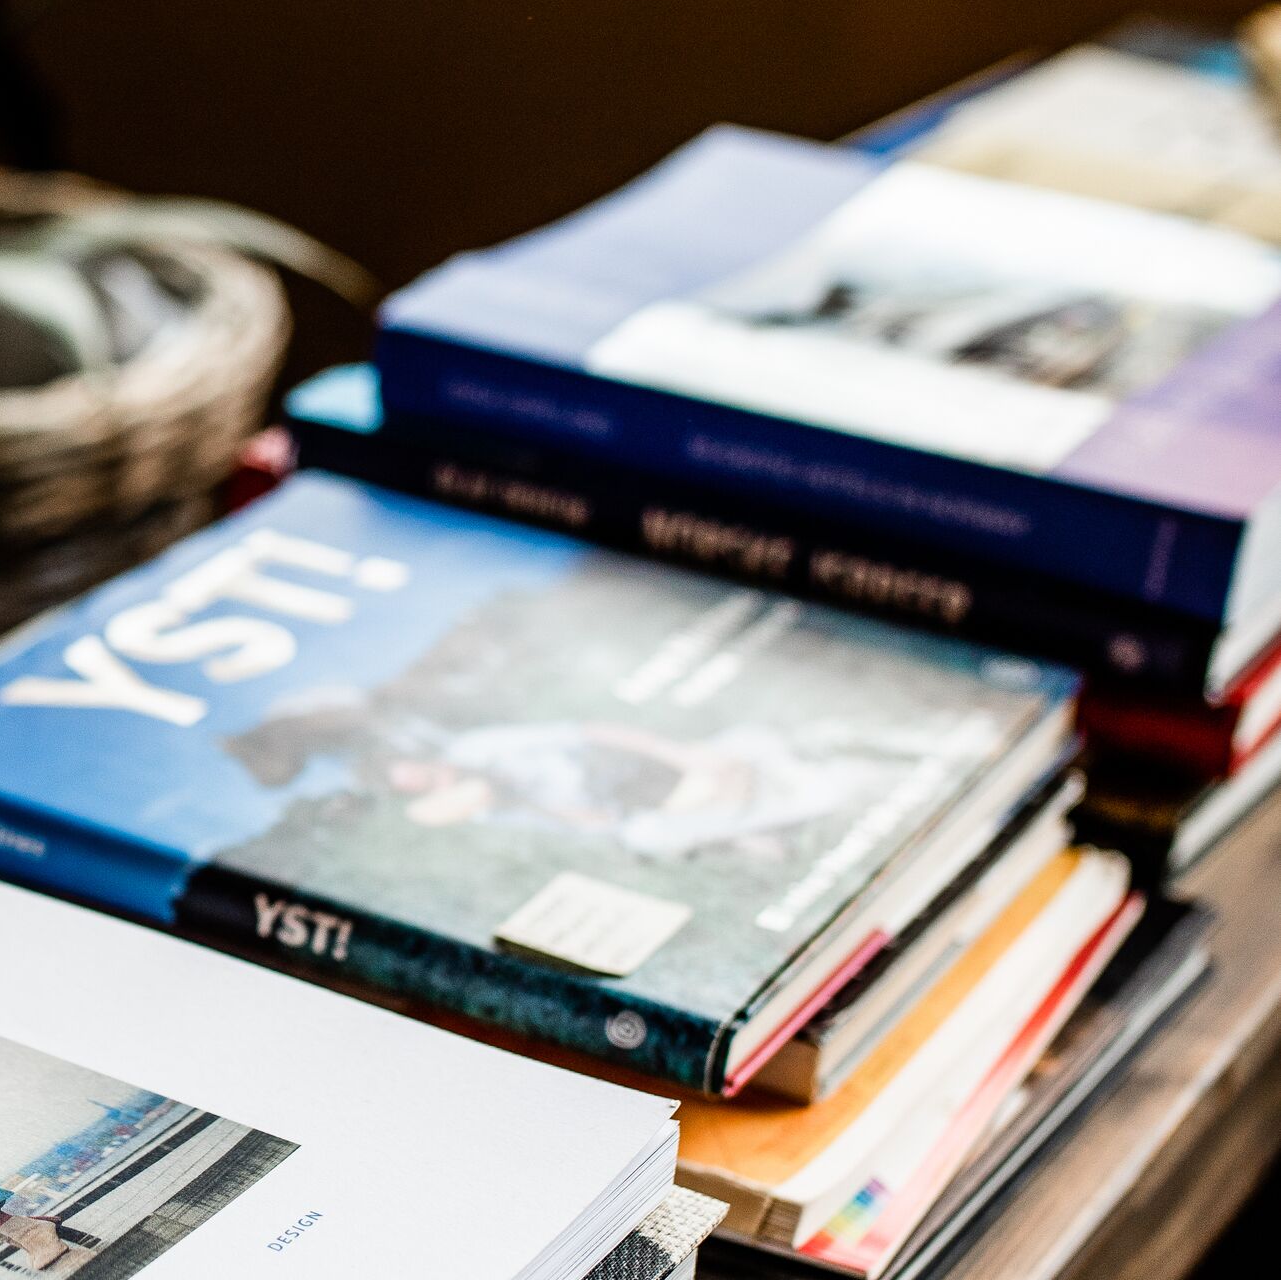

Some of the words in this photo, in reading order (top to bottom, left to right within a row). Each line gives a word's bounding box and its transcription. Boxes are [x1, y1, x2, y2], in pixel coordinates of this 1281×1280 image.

[0, 528, 411, 728] YST!
[254, 893, 354, 961] YST!
[266, 1210, 324, 1253] DESIGN
